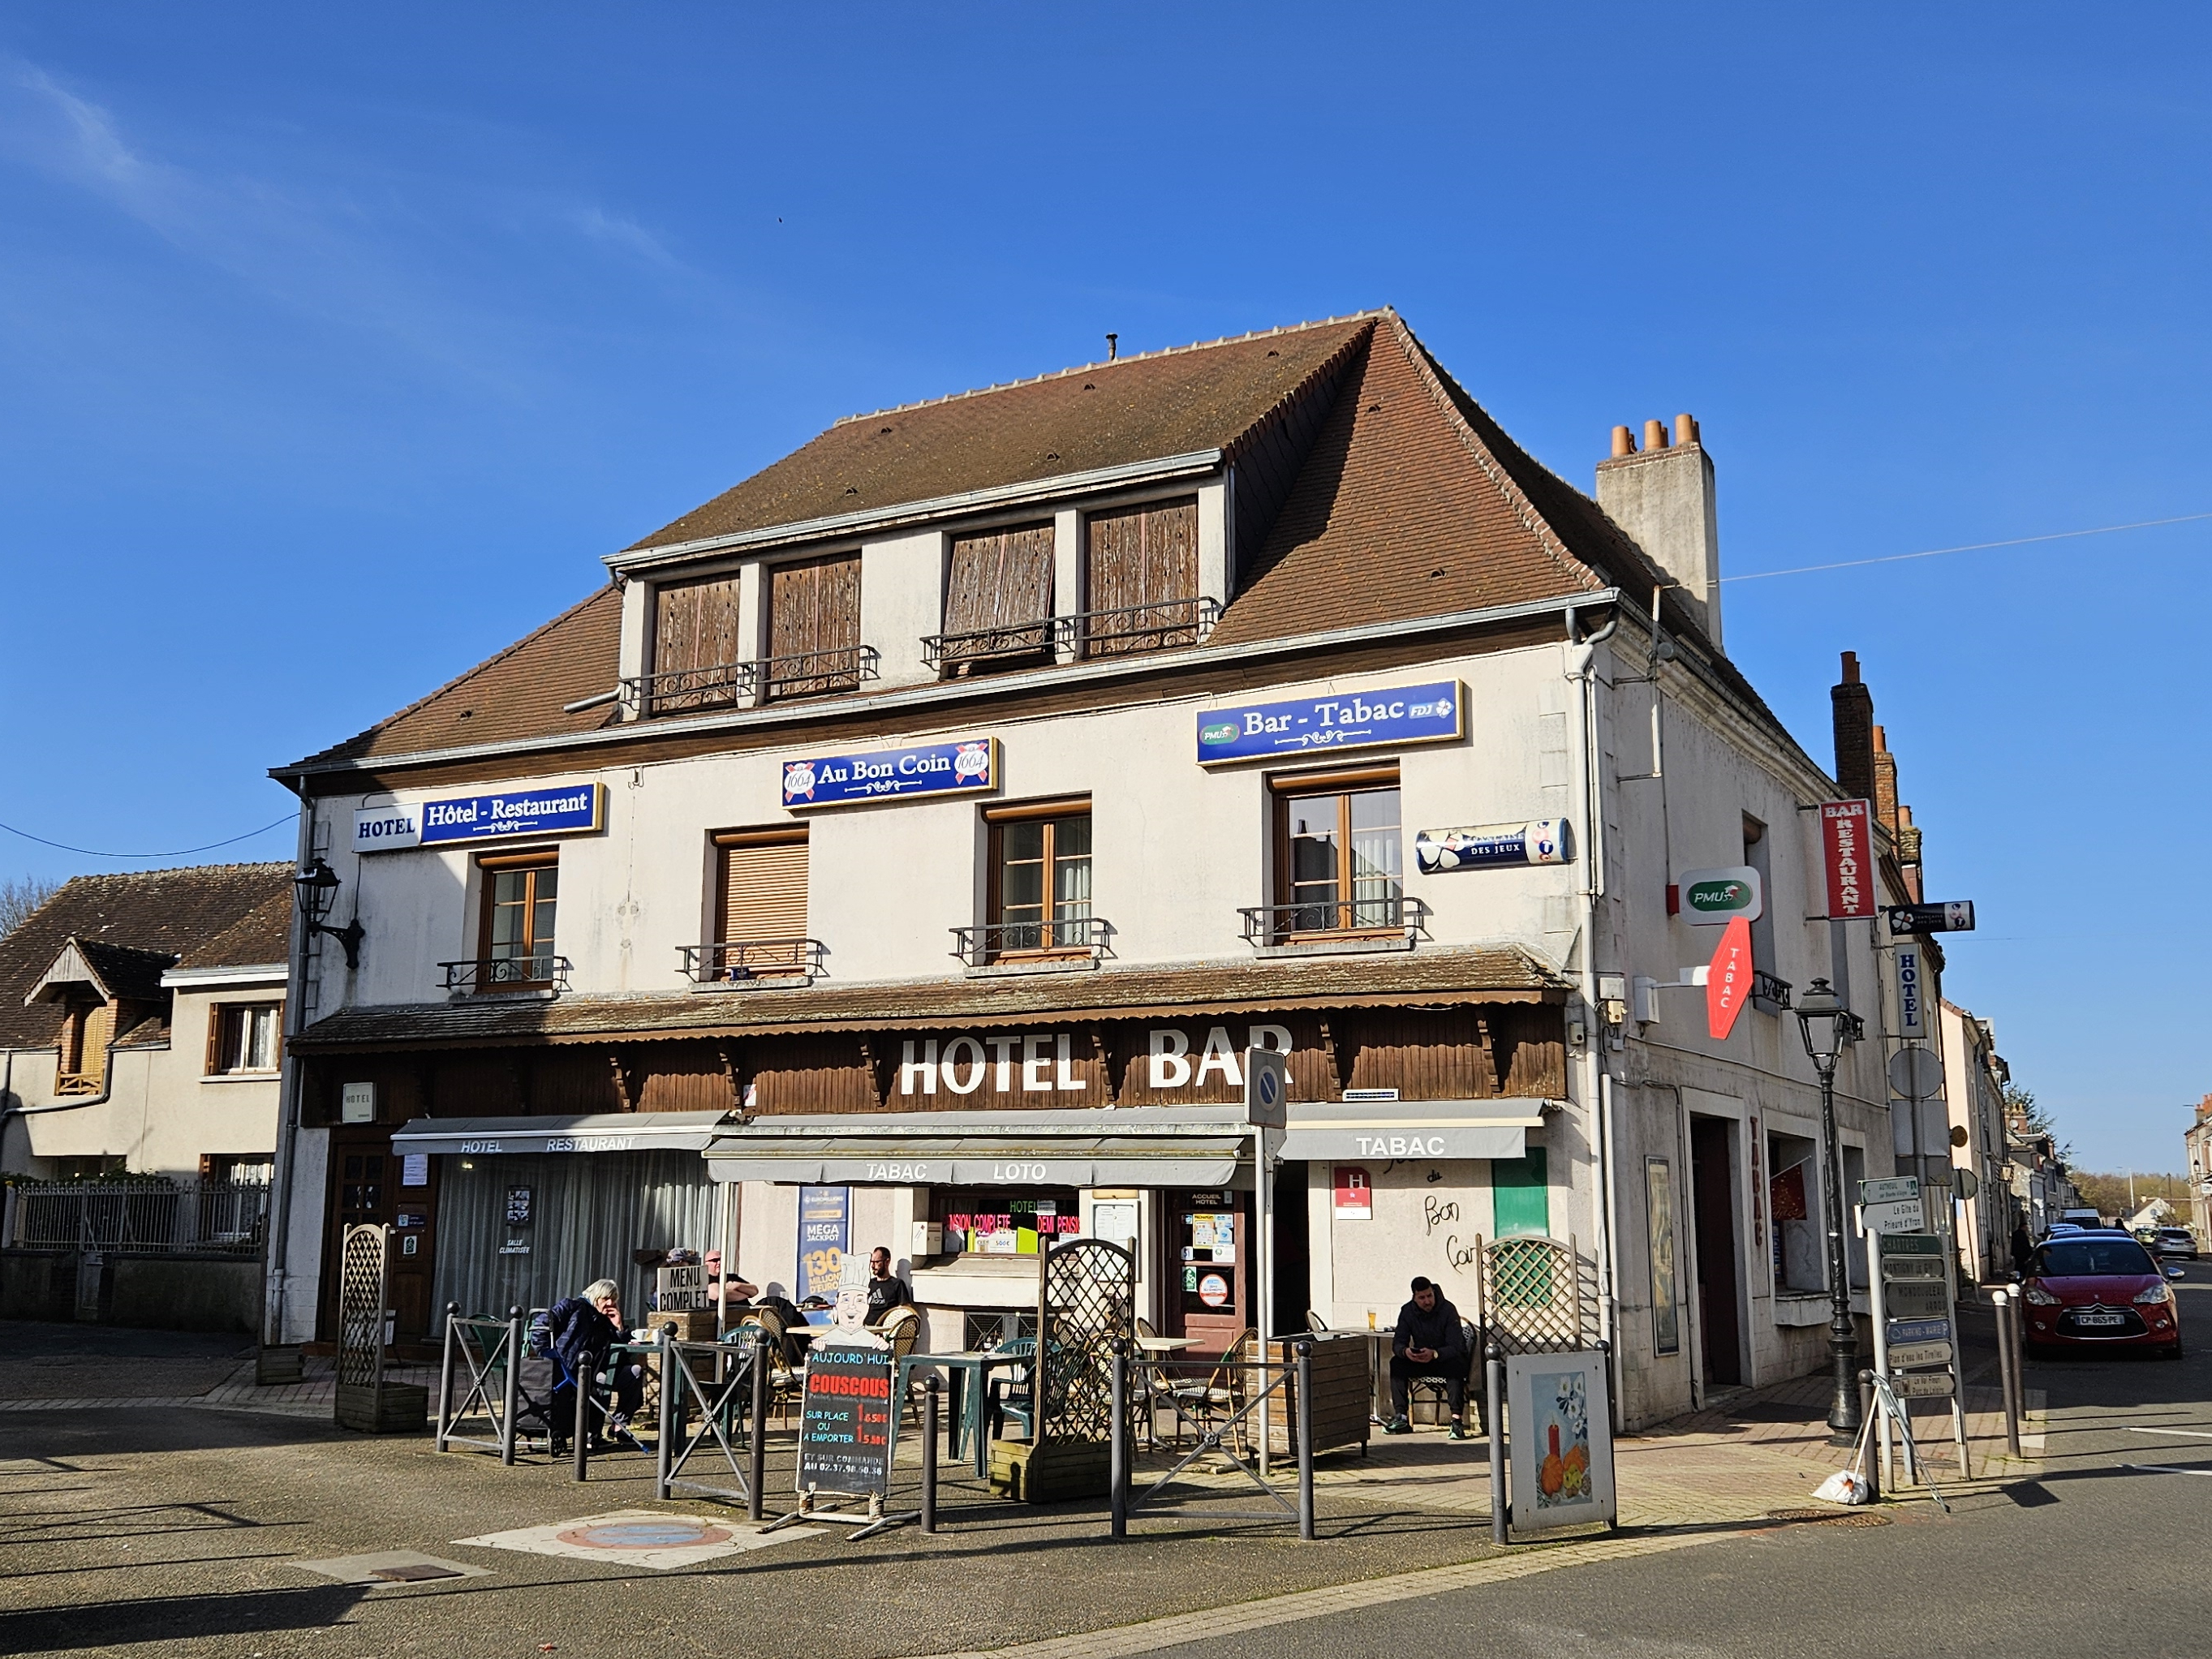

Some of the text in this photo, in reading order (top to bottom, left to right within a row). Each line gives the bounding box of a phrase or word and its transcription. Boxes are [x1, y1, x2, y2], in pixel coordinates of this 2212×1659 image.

[1204, 730, 1223, 740] PMU
[1243, 712, 1292, 735] Bar
[1315, 698, 1405, 727] Tabac
[1410, 704, 1432, 717] FDJ
[787, 754, 985, 788] 1664 Au Bon Coin 1664
[427, 800, 477, 827] Hôtel
[491, 793, 587, 820] Restaurant
[1825, 804, 1864, 818] BAR
[359, 818, 415, 839] HOTEL
[1470, 844, 1521, 855] DES JEUX
[1836, 819, 1860, 914] RESTAURANT
[1694, 892, 1724, 904] PMU
[1720, 948, 1739, 1008] TABAC
[1900, 954, 1918, 1027] HOTEL
[901, 1034, 1087, 1095] HOTEL
[1149, 1025, 1294, 1089] BAR
[346, 1094, 369, 1103] HOTEL
[460, 1137, 635, 1154] HOTEL RESTAURANT
[1356, 1137, 1445, 1156] TABAC
[866, 1163, 927, 1180] TABAC
[992, 1163, 1047, 1180] LOTO
[1427, 1170, 1443, 1183] du
[1349, 1174, 1365, 1188] H
[1037, 1215, 1055, 1233] DEMI
[1425, 1195, 1460, 1236] Bon
[807, 1234, 840, 1242] JACKPOT
[1883, 1238, 1919, 1251] CHARTRES
[802, 1247, 841, 1277] 130
[670, 1267, 700, 1288] MENU
[809, 1273, 841, 1286] MILLION
[810, 1282, 839, 1294] D'EURO
[661, 1291, 708, 1311] COMPLET
[812, 1352, 889, 1365] AUJOURD'HUI
[809, 1373, 889, 1398] COUSCOUS
[806, 1410, 823, 1419] SUR
[824, 1412, 849, 1421] PLACE
[817, 1422, 830, 1431] OU
[803, 1433, 810, 1441] A
[811, 1433, 854, 1443] EMPORTER
[804, 1462, 817, 1471] AU
[817, 1454, 834, 1462] SUR
